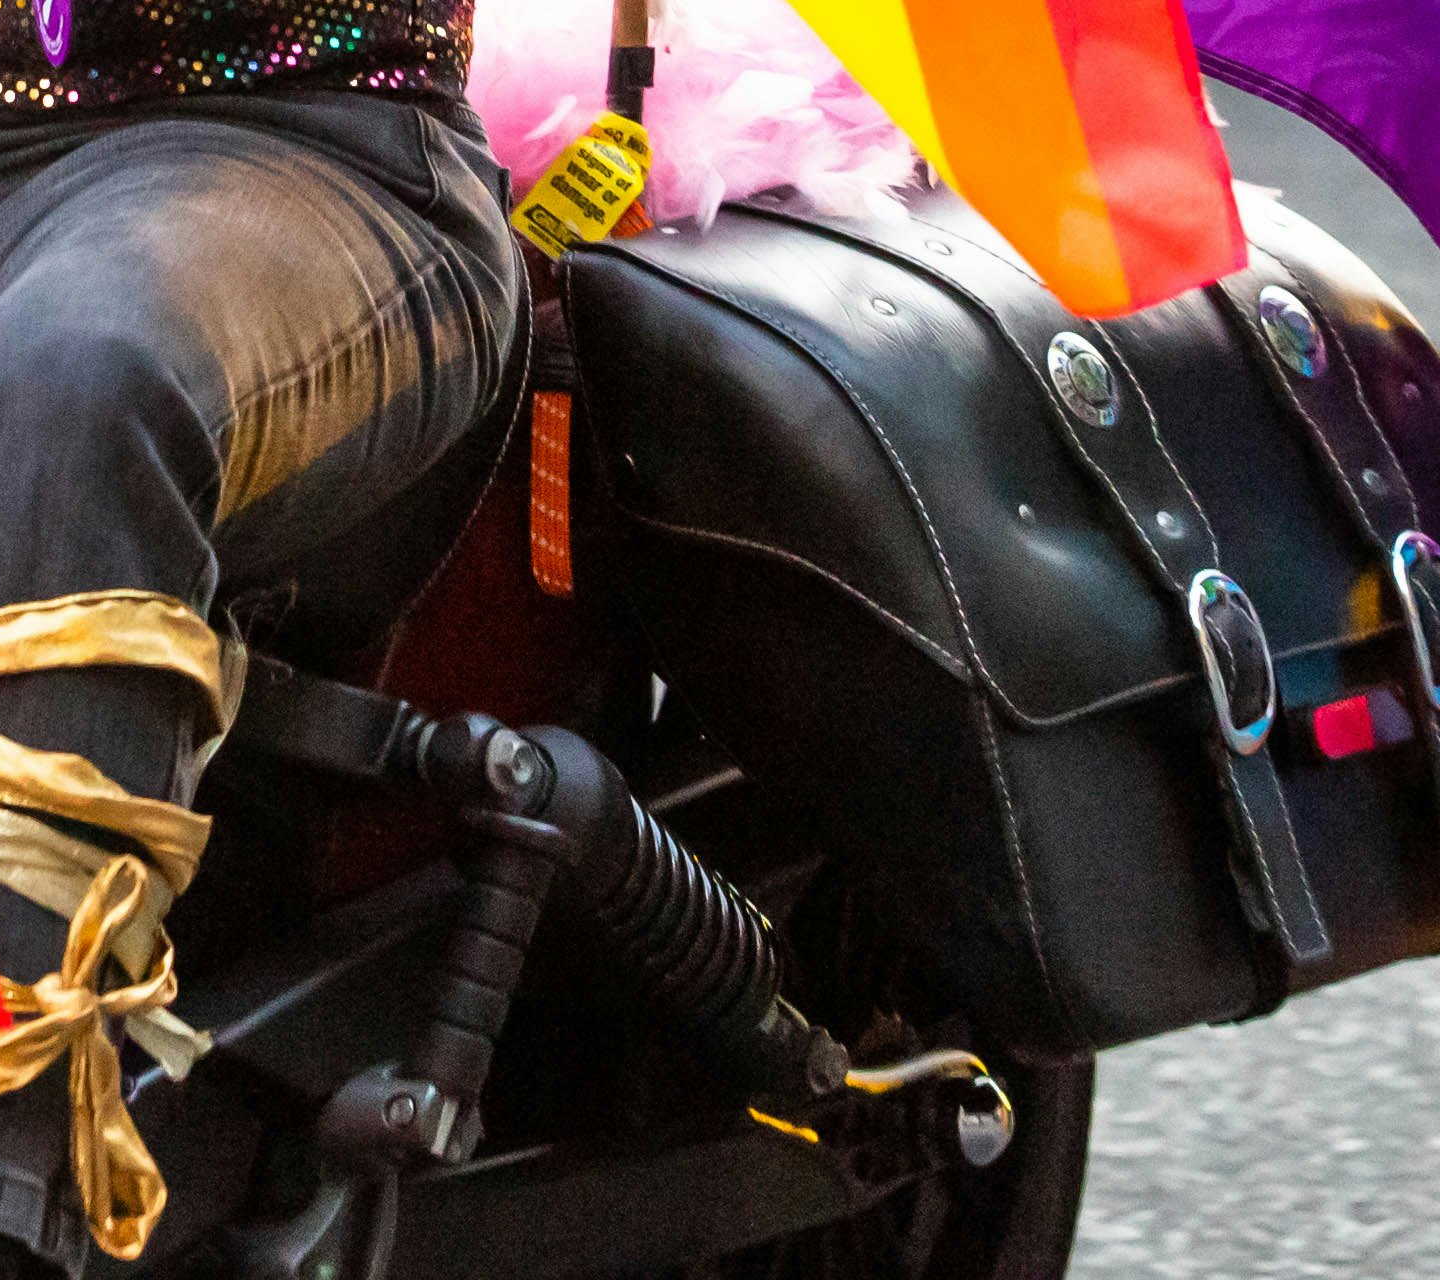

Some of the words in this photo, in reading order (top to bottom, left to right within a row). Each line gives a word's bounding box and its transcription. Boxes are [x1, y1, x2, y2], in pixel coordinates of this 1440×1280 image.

[567, 161, 603, 191] wear
[602, 190, 620, 205] or
[577, 148, 614, 178] signs
[616, 178, 632, 192] of
[550, 175, 606, 225] damage.
